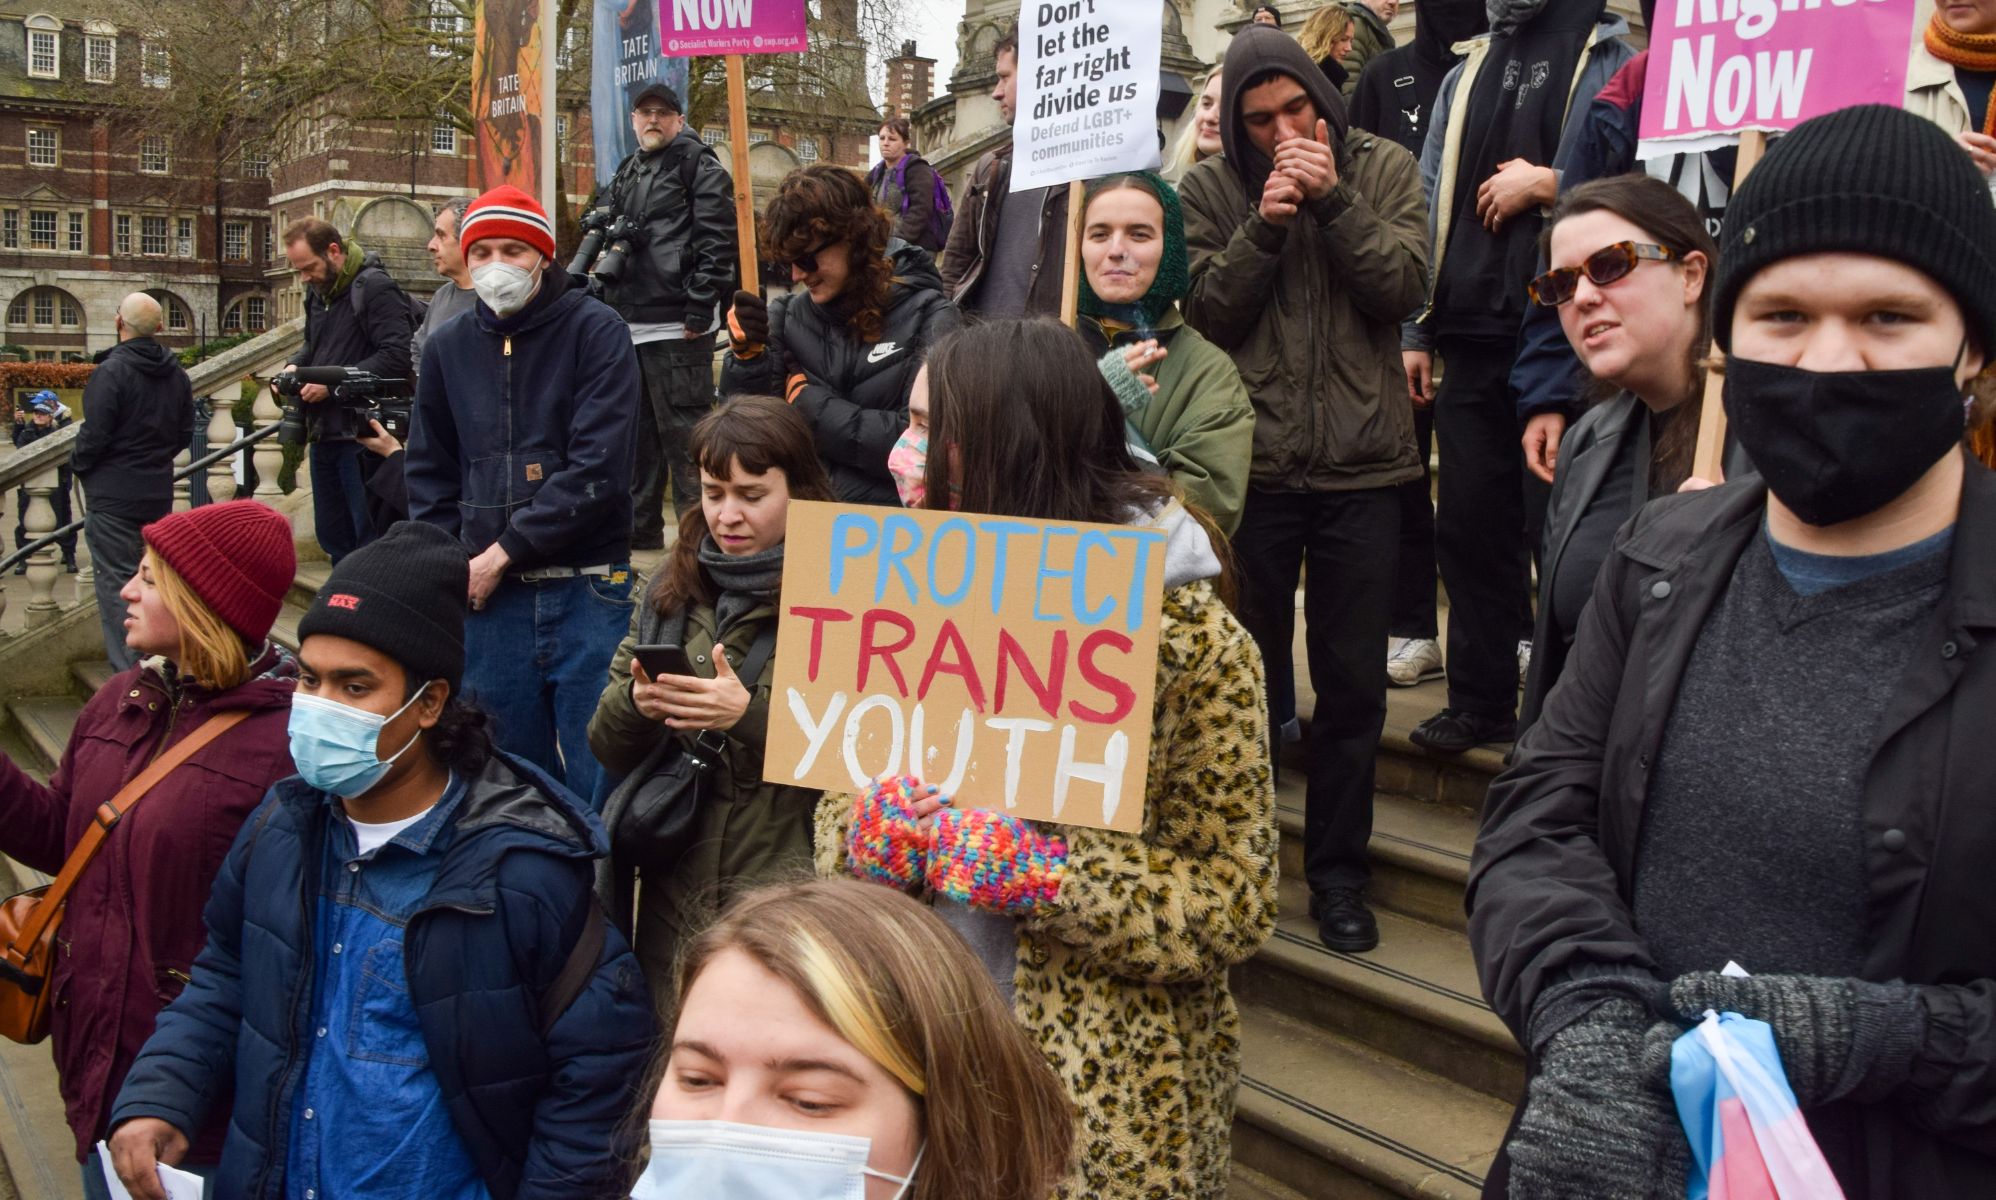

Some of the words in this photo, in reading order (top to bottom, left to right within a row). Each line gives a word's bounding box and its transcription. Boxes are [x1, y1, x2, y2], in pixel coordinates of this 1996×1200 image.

[1037, 0, 1095, 28] Dont
[623, 34, 648, 59] TATE
[679, 39, 707, 49] Socialist
[707, 38, 731, 48] Workers
[732, 37, 750, 49] Party
[1037, 31, 1066, 59] let
[1072, 22, 1110, 49] the
[498, 73, 519, 94] TATE
[614, 58, 658, 86] BRITAIN
[1035, 64, 1067, 90] far
[1072, 46, 1131, 82] right
[491, 95, 527, 118] BRITAIN
[1033, 84, 1100, 120] divide
[1108, 82, 1137, 103] us
[1031, 116, 1080, 143] Defend
[1083, 107, 1132, 131] LGBT+
[1031, 131, 1125, 162] communities
[829, 513, 1169, 633] PROTECT
[789, 606, 1137, 725] TRANS
[786, 686, 1130, 826] YOUTH
